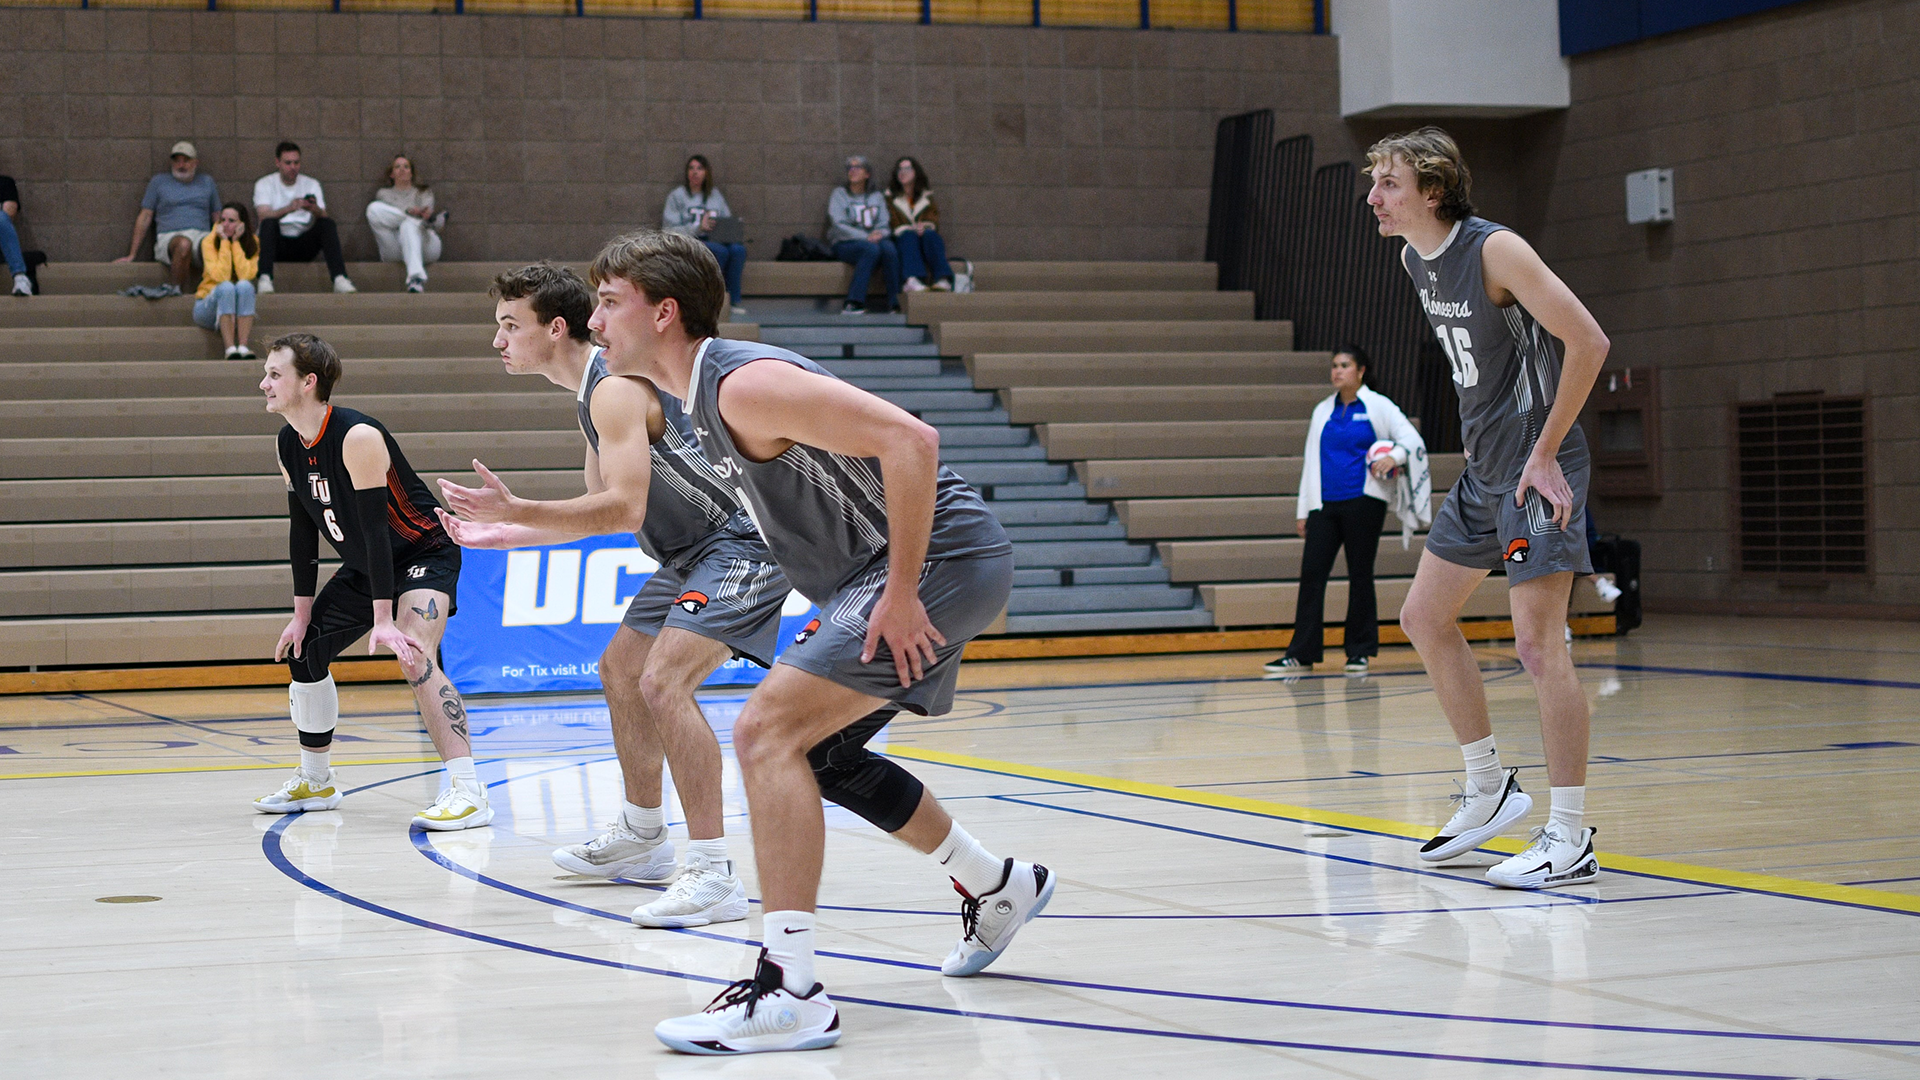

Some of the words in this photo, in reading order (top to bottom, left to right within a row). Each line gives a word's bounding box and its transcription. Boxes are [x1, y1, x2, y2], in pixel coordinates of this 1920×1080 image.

[1420, 288, 1473, 319] Pioneers
[1436, 324, 1479, 388] 16
[308, 472, 331, 505] TU
[323, 508, 345, 542] 6
[502, 547, 660, 627] UC
[502, 666, 525, 678] For
[528, 664, 549, 677] Tix
[551, 663, 578, 676] visit
[723, 657, 744, 669] call
